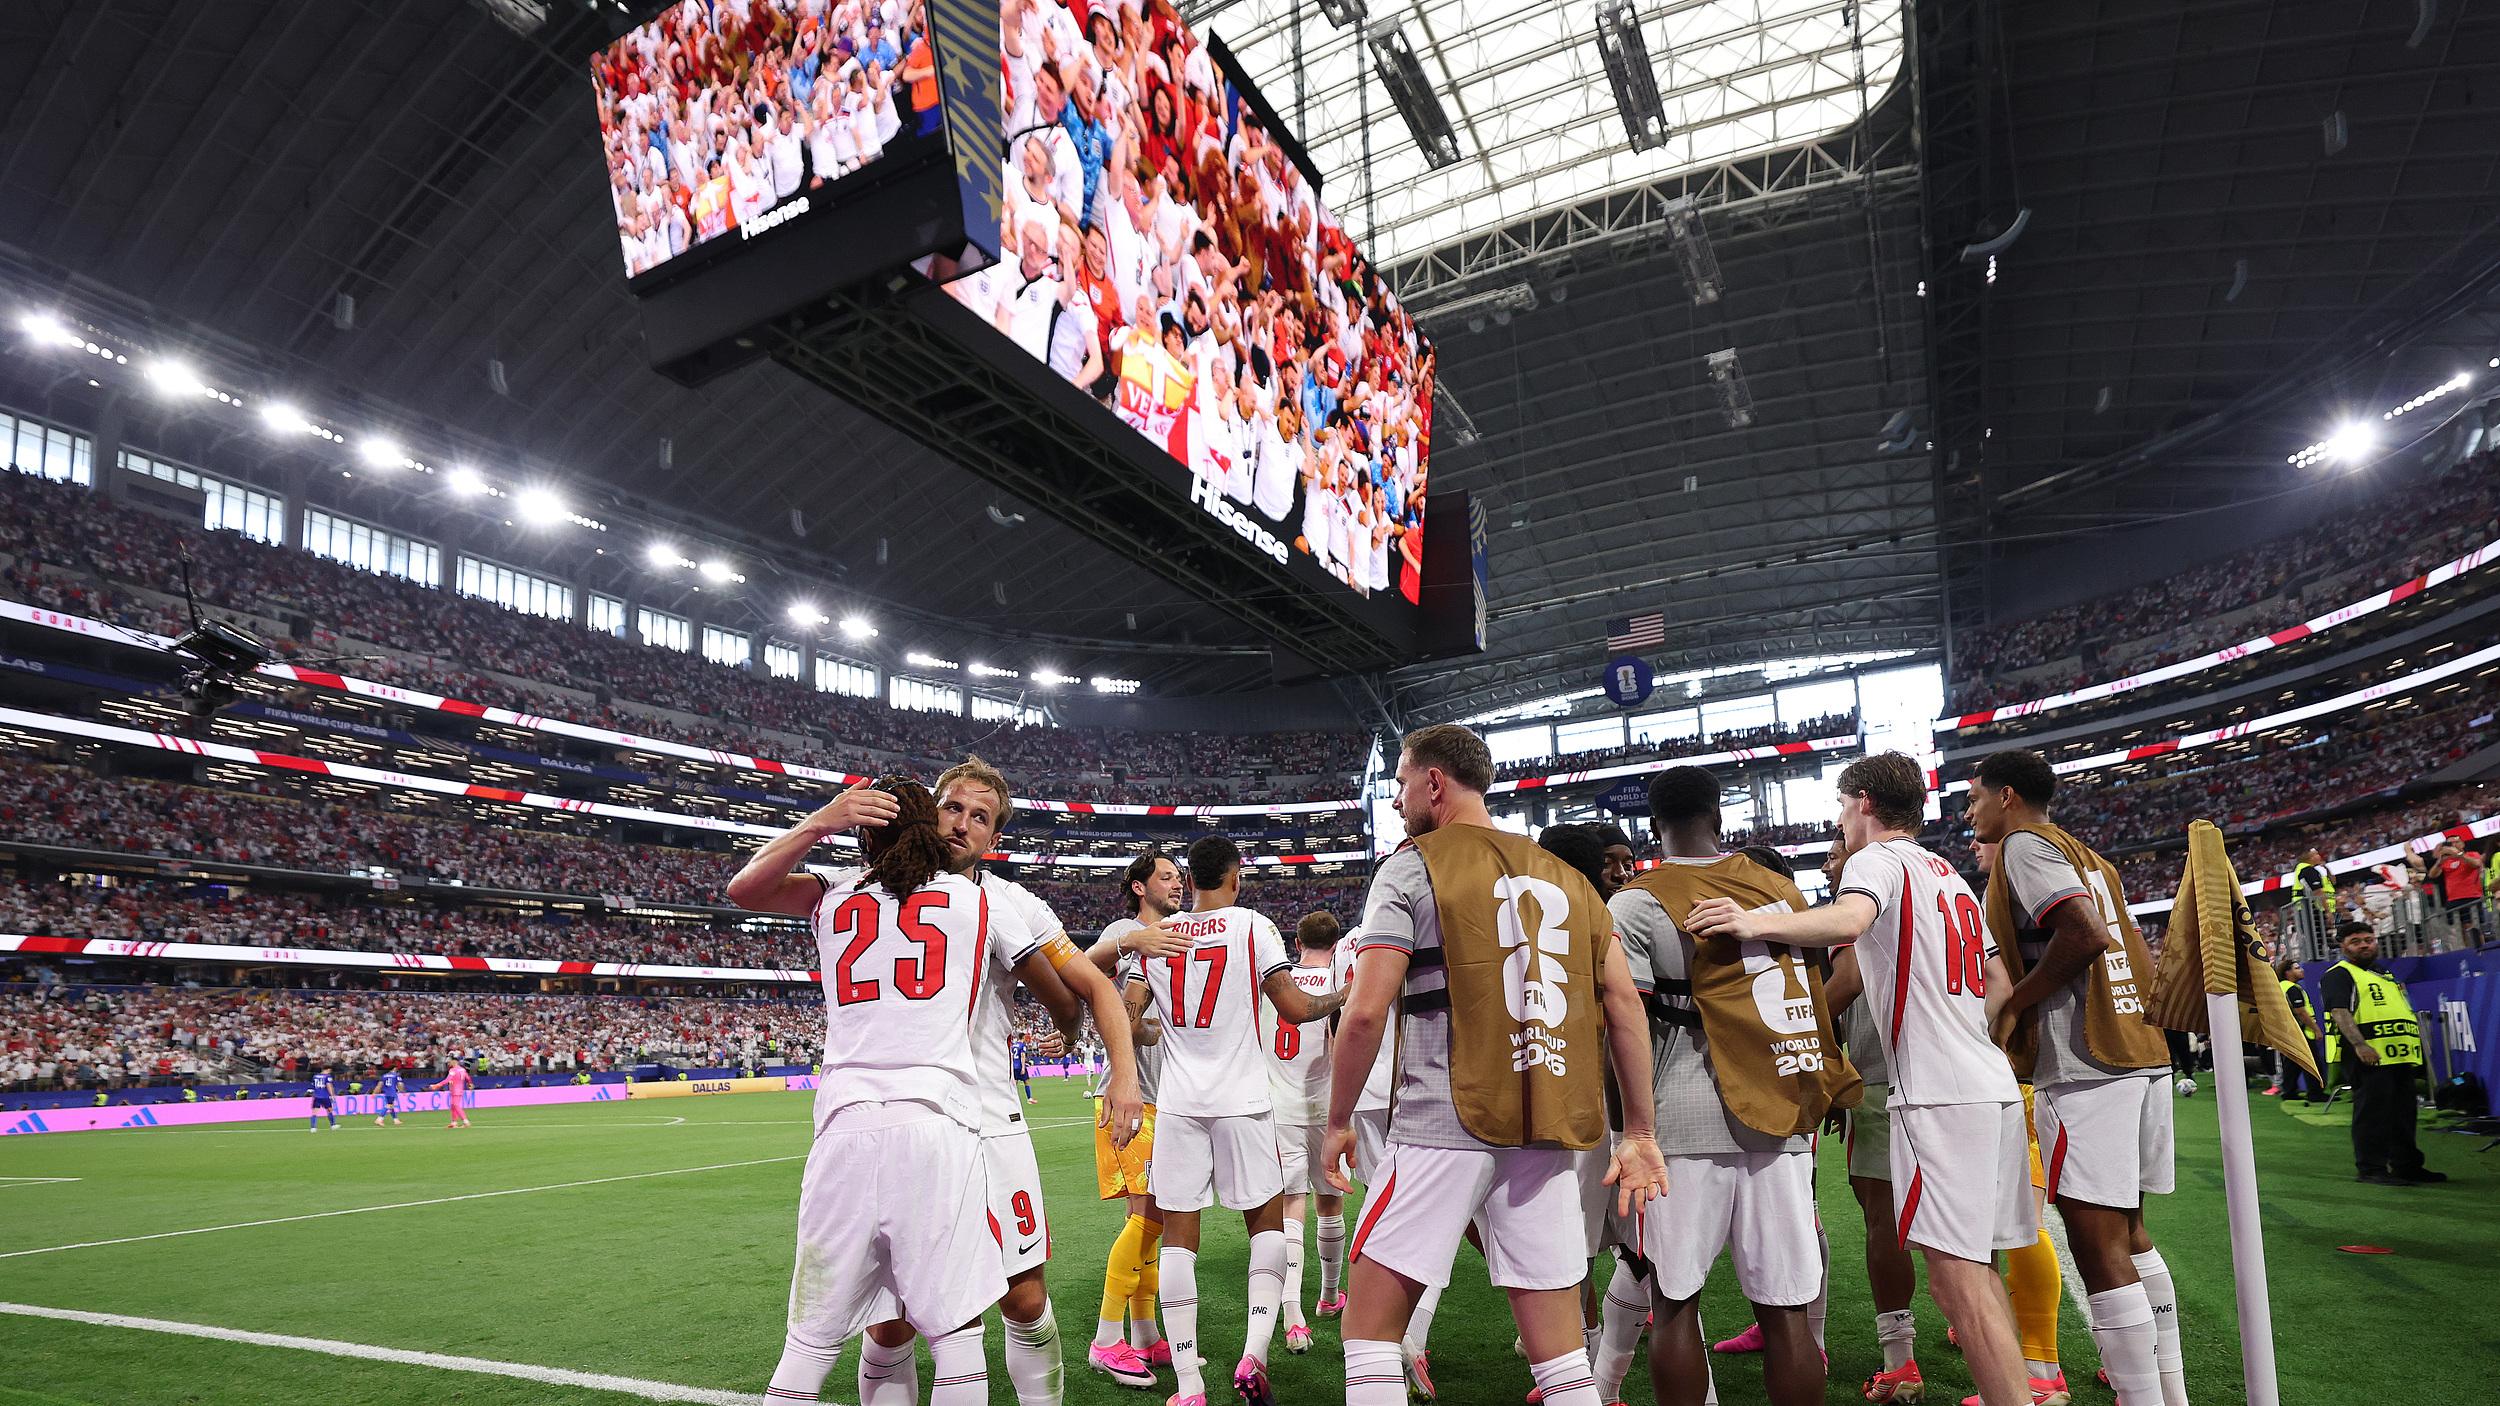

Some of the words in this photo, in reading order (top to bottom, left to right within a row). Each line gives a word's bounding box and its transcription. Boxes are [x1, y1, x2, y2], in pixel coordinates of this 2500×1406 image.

[740, 196, 810, 240] Hisense
[1190, 472, 1289, 565] Hisense
[32, 610, 88, 631] GOAL
[0, 655, 45, 673] LAS
[290, 712, 329, 727] WORLD
[330, 719, 351, 730] CUP
[540, 756, 593, 773] DALLAS
[1609, 792, 1639, 802] WORLD
[1623, 785, 1641, 794] FIFA
[1172, 918, 1227, 937] ROGERS
[833, 890, 950, 1007] 25
[1936, 888, 1986, 999] 18
[1166, 945, 1228, 1028] 17
[1293, 975, 1327, 987] ERSON
[1274, 1014, 1301, 1061] 8
[2373, 1022, 2420, 1036] SECUR
[1013, 1047, 1019, 1059] 2
[1770, 1036, 1820, 1056] WORLD
[692, 1082, 731, 1093] DALLAS
[1011, 1190, 1036, 1236] 9
[1251, 1306, 1268, 1315] ENG
[2151, 1303, 2173, 1314] ENG
[1176, 1340, 1193, 1352] ENG
